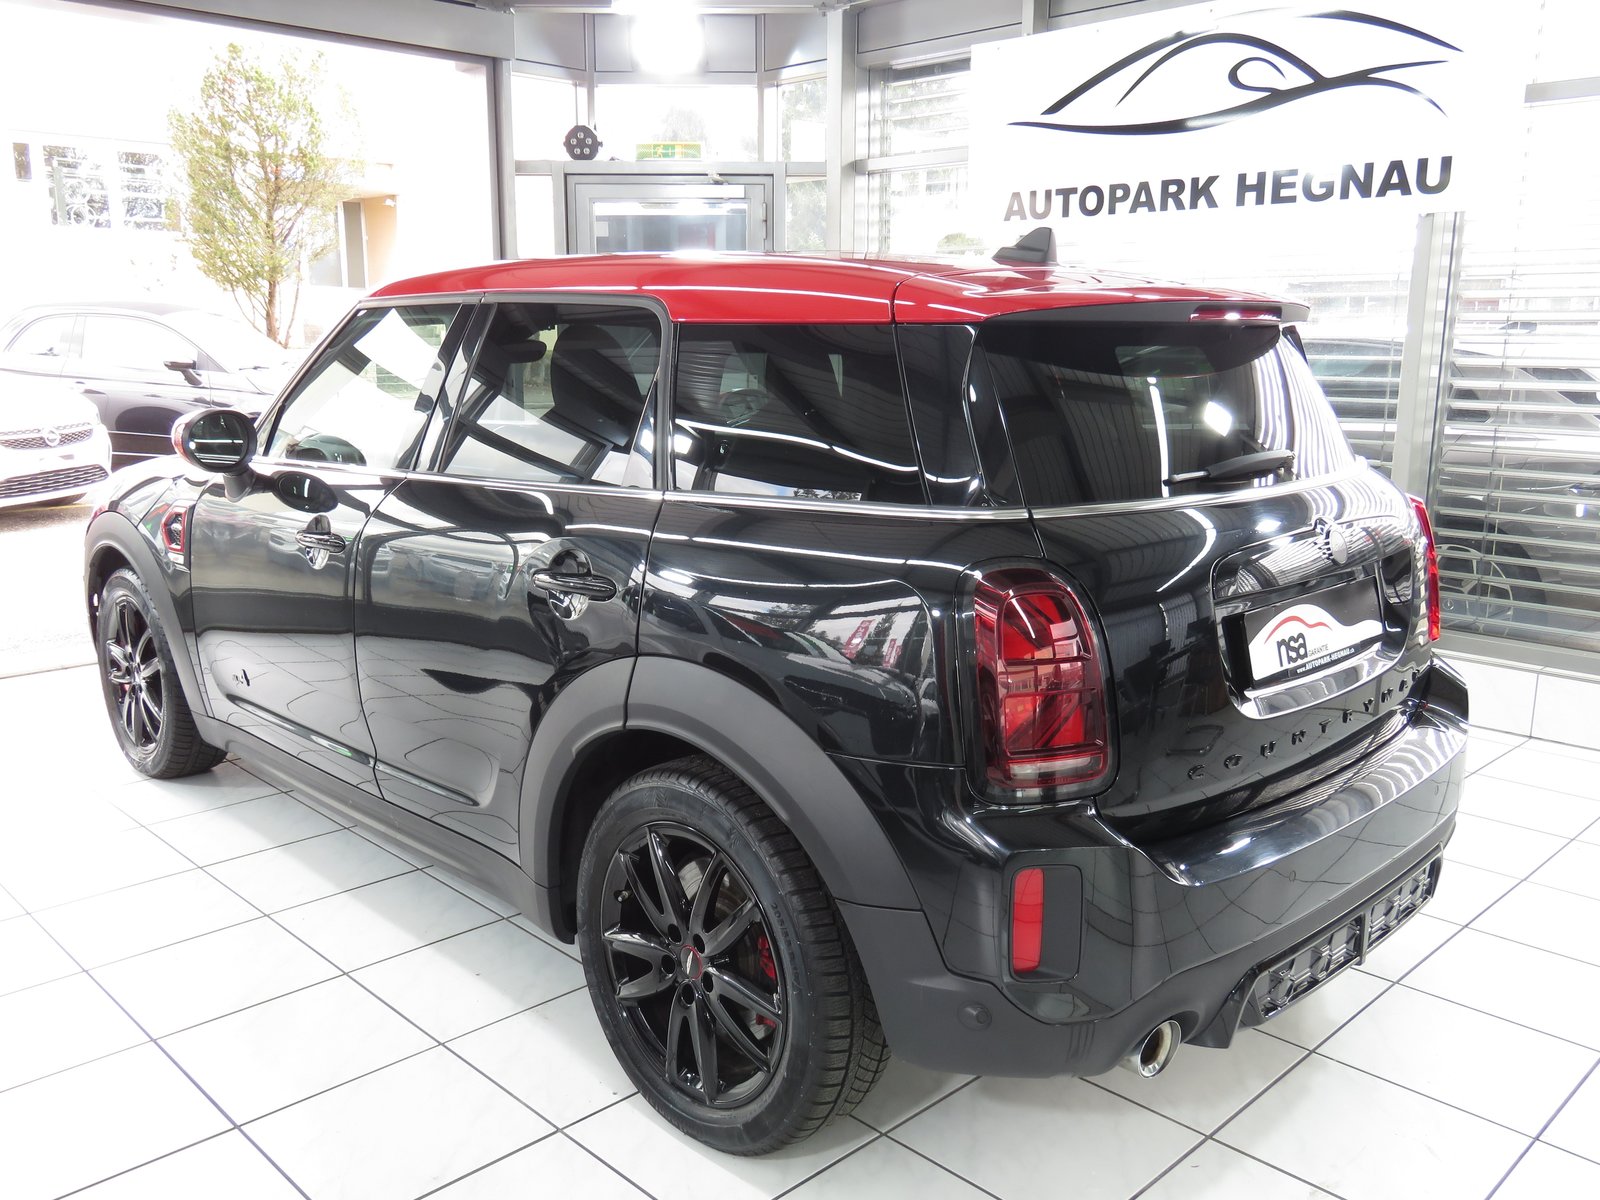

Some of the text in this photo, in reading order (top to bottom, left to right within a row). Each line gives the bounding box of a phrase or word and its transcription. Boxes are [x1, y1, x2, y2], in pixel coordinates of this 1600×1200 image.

[1003, 155, 1453, 222] AUTOPARK HEGNAU
[1276, 632, 1308, 667] nsa
